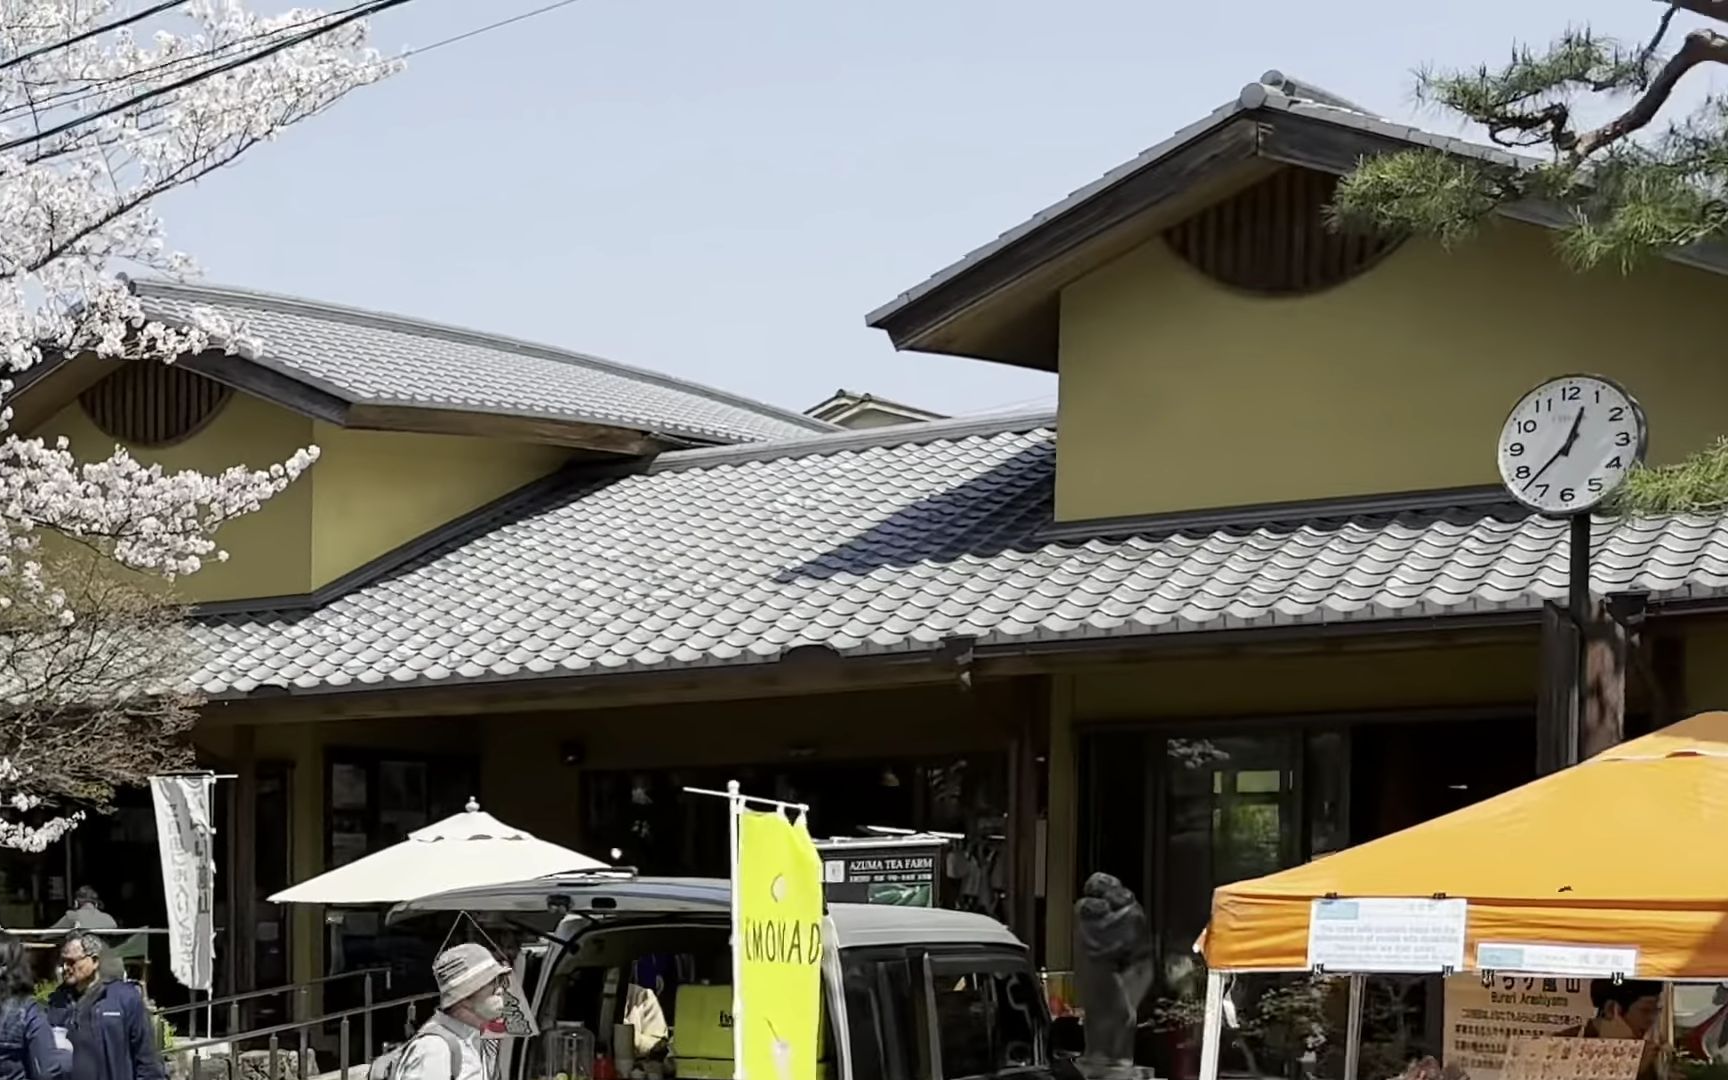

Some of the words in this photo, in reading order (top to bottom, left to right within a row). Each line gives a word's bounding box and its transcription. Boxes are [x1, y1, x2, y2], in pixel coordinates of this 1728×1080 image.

[1561, 386, 1581, 402] 12
[1594, 389, 1600, 404] 1
[1535, 398, 1552, 413] 11
[1608, 406, 1624, 422] 2
[1517, 420, 1537, 434] 10
[1615, 431, 1631, 447] 3
[1509, 442, 1525, 457] 9
[1605, 455, 1623, 470] 4
[1515, 465, 1531, 479] 8
[1535, 483, 1550, 498] 7
[1587, 477, 1603, 492] 5
[1559, 488, 1576, 503] 6
[884, 860, 904, 870] TEA
[904, 858, 933, 869] FARM
